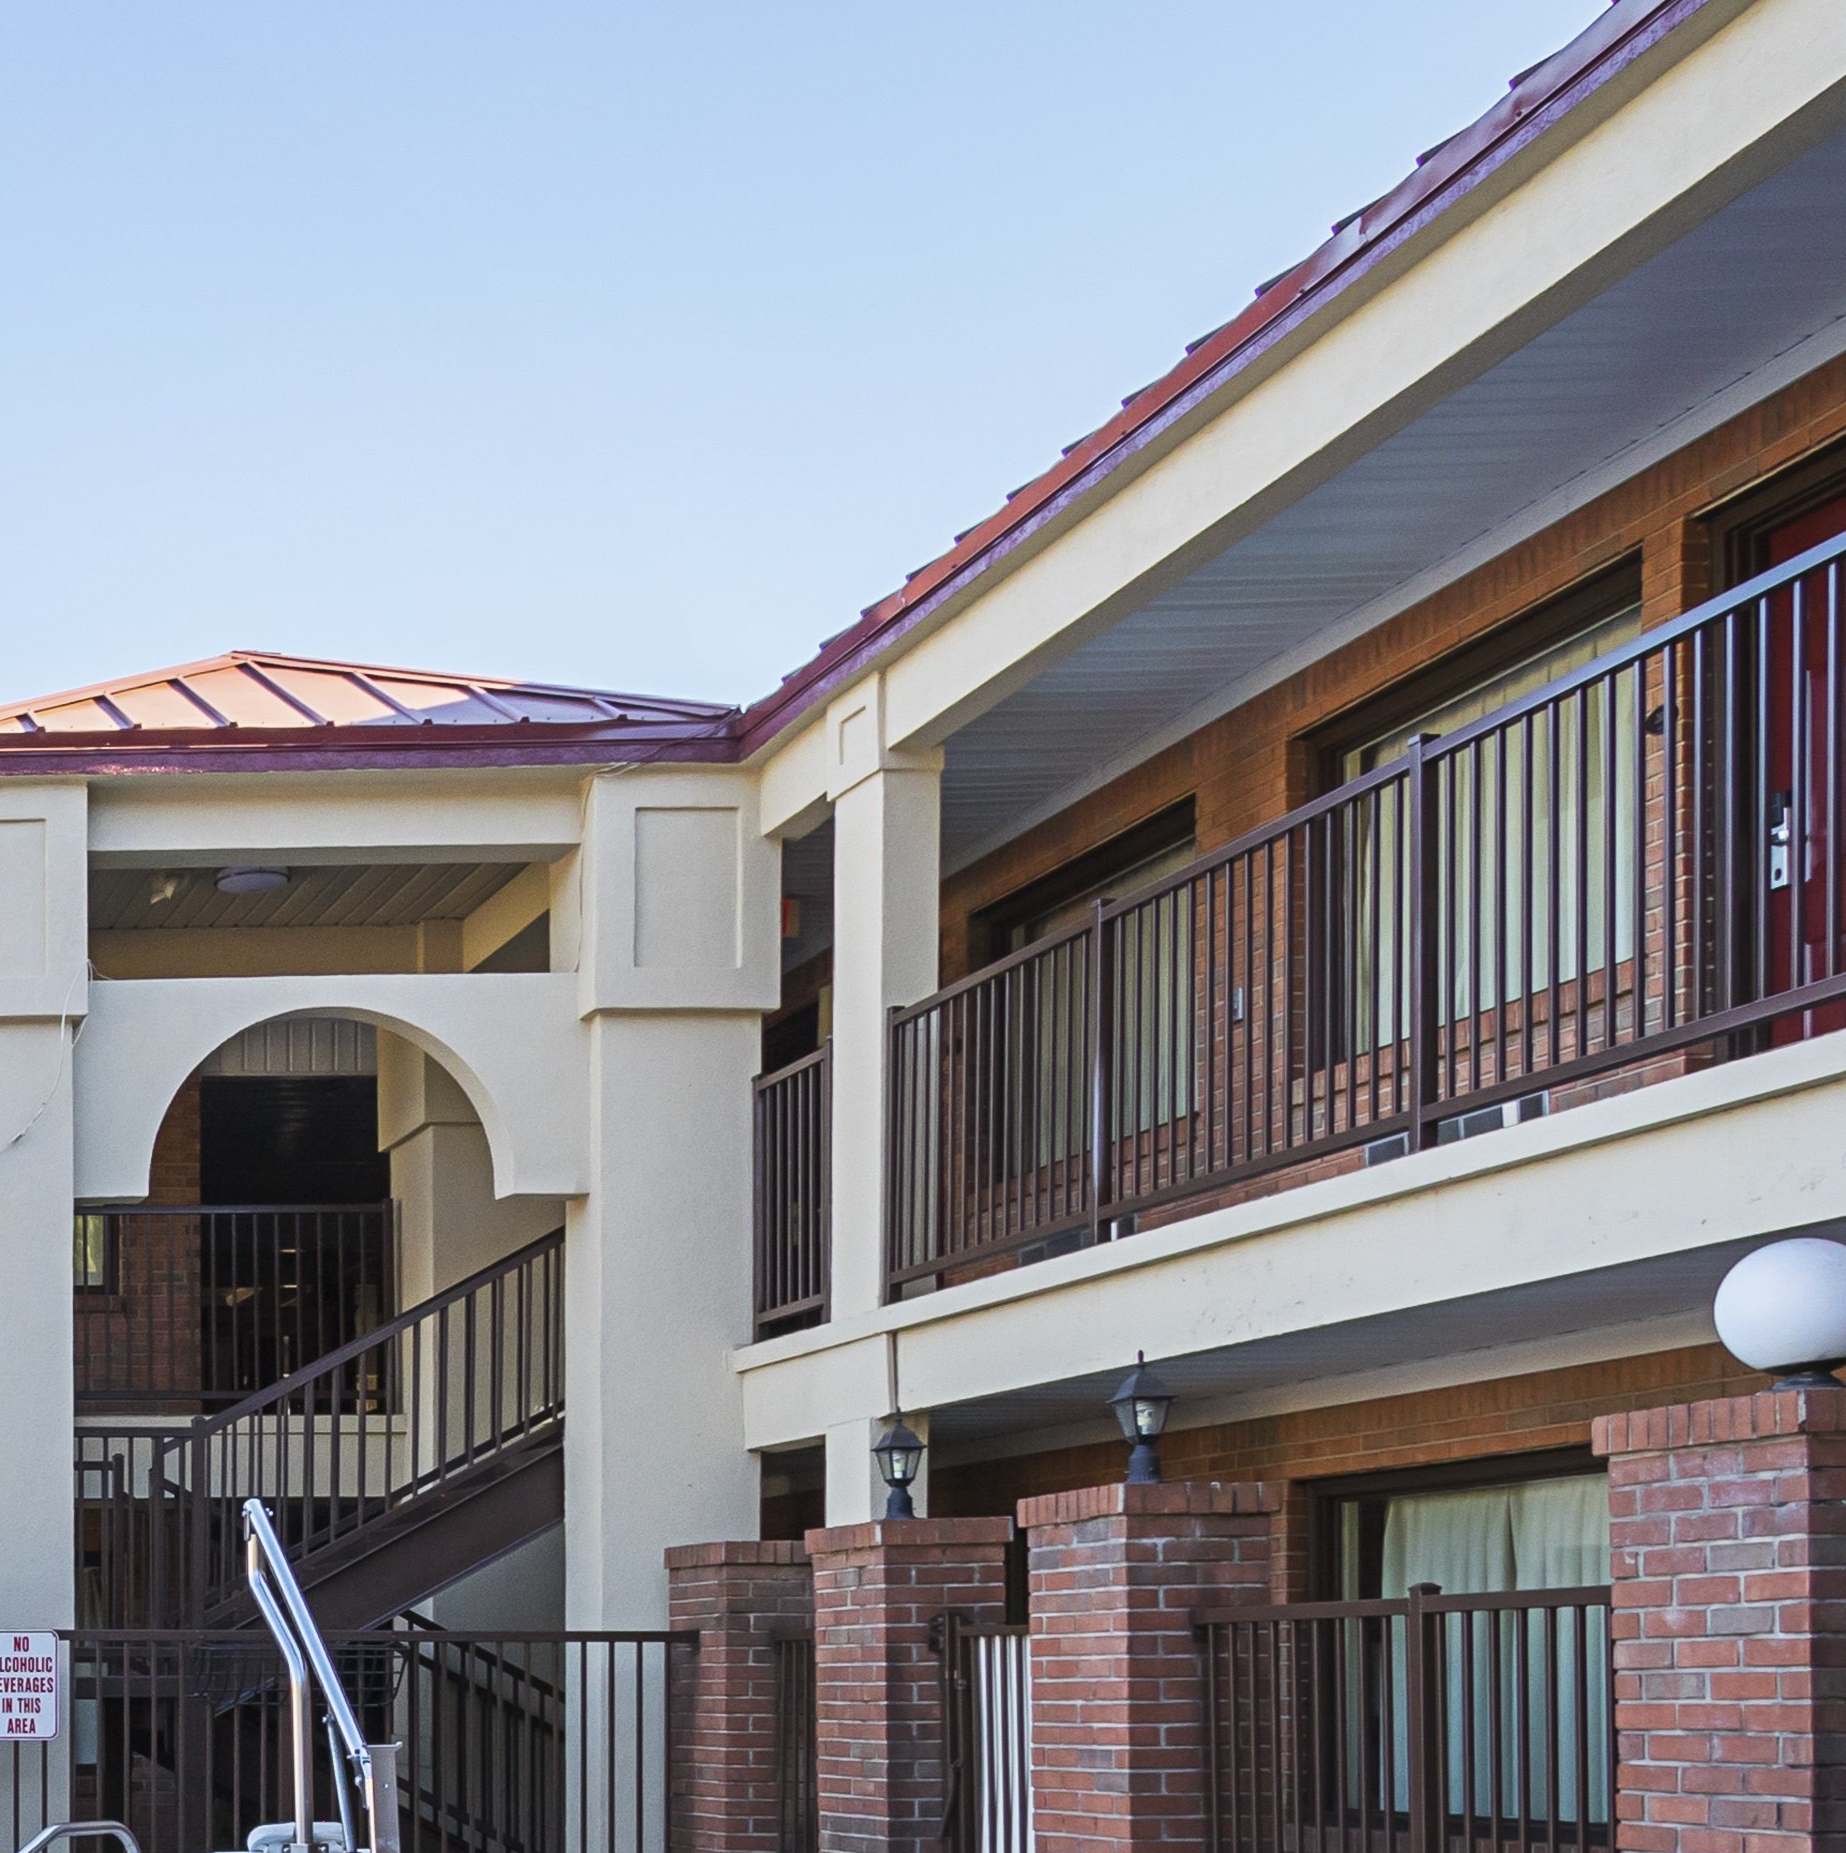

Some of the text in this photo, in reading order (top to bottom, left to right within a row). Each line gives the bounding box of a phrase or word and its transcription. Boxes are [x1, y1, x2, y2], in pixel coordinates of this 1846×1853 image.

[13, 1636, 29, 1652] NO
[1, 1698, 41, 1713] IN THIS
[6, 1718, 36, 1734] AREA
